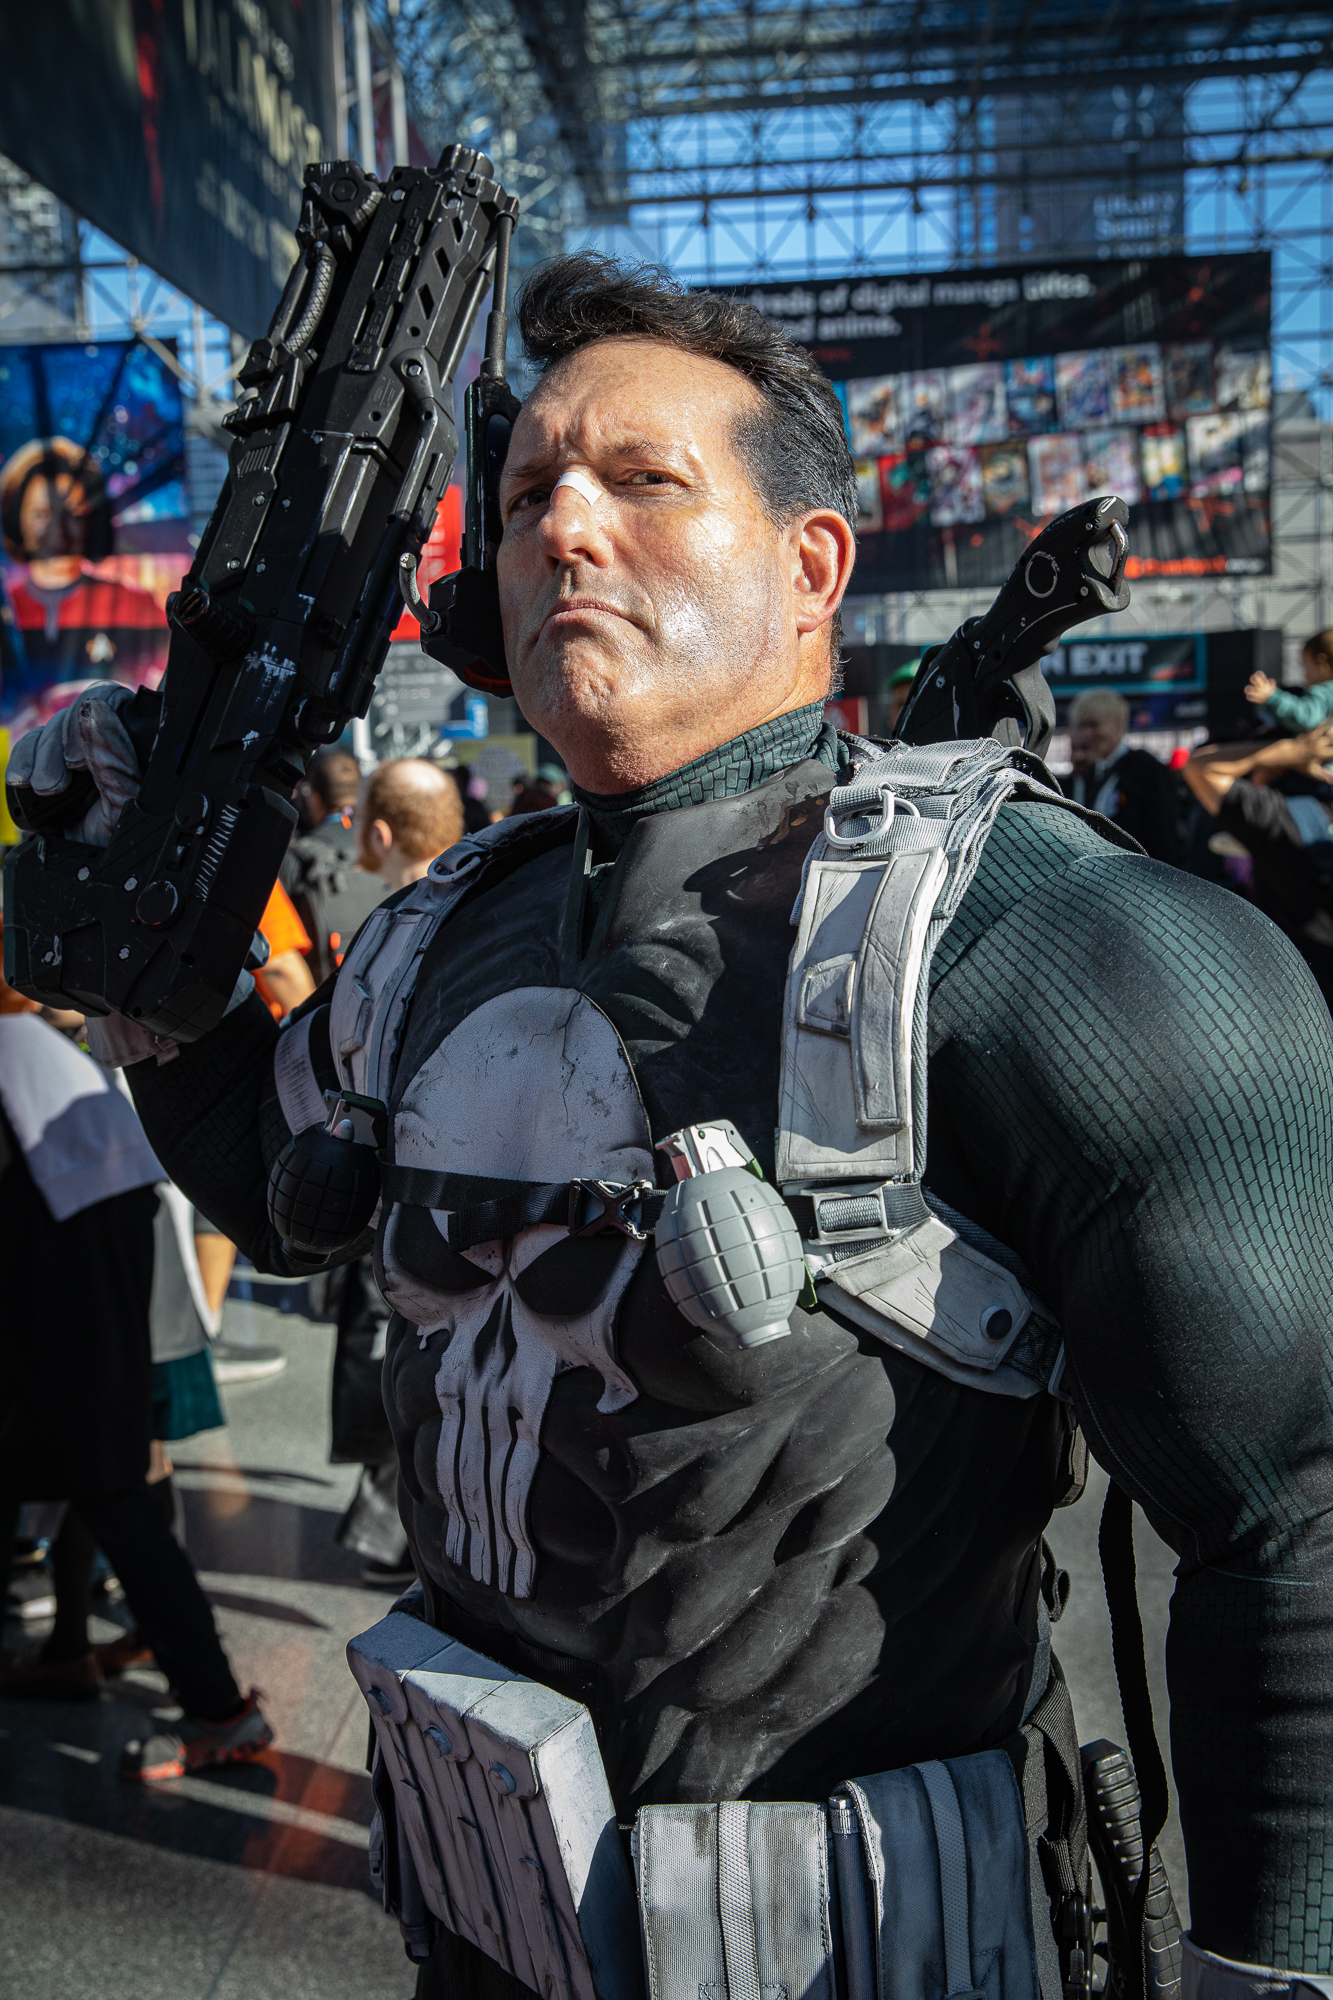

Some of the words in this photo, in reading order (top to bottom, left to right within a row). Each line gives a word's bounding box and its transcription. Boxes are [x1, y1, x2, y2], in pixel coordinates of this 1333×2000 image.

[819, 283, 849, 313] of
[852, 278, 931, 314] digital
[933, 278, 1019, 309] manga
[1068, 642, 1147, 676] EXIT
